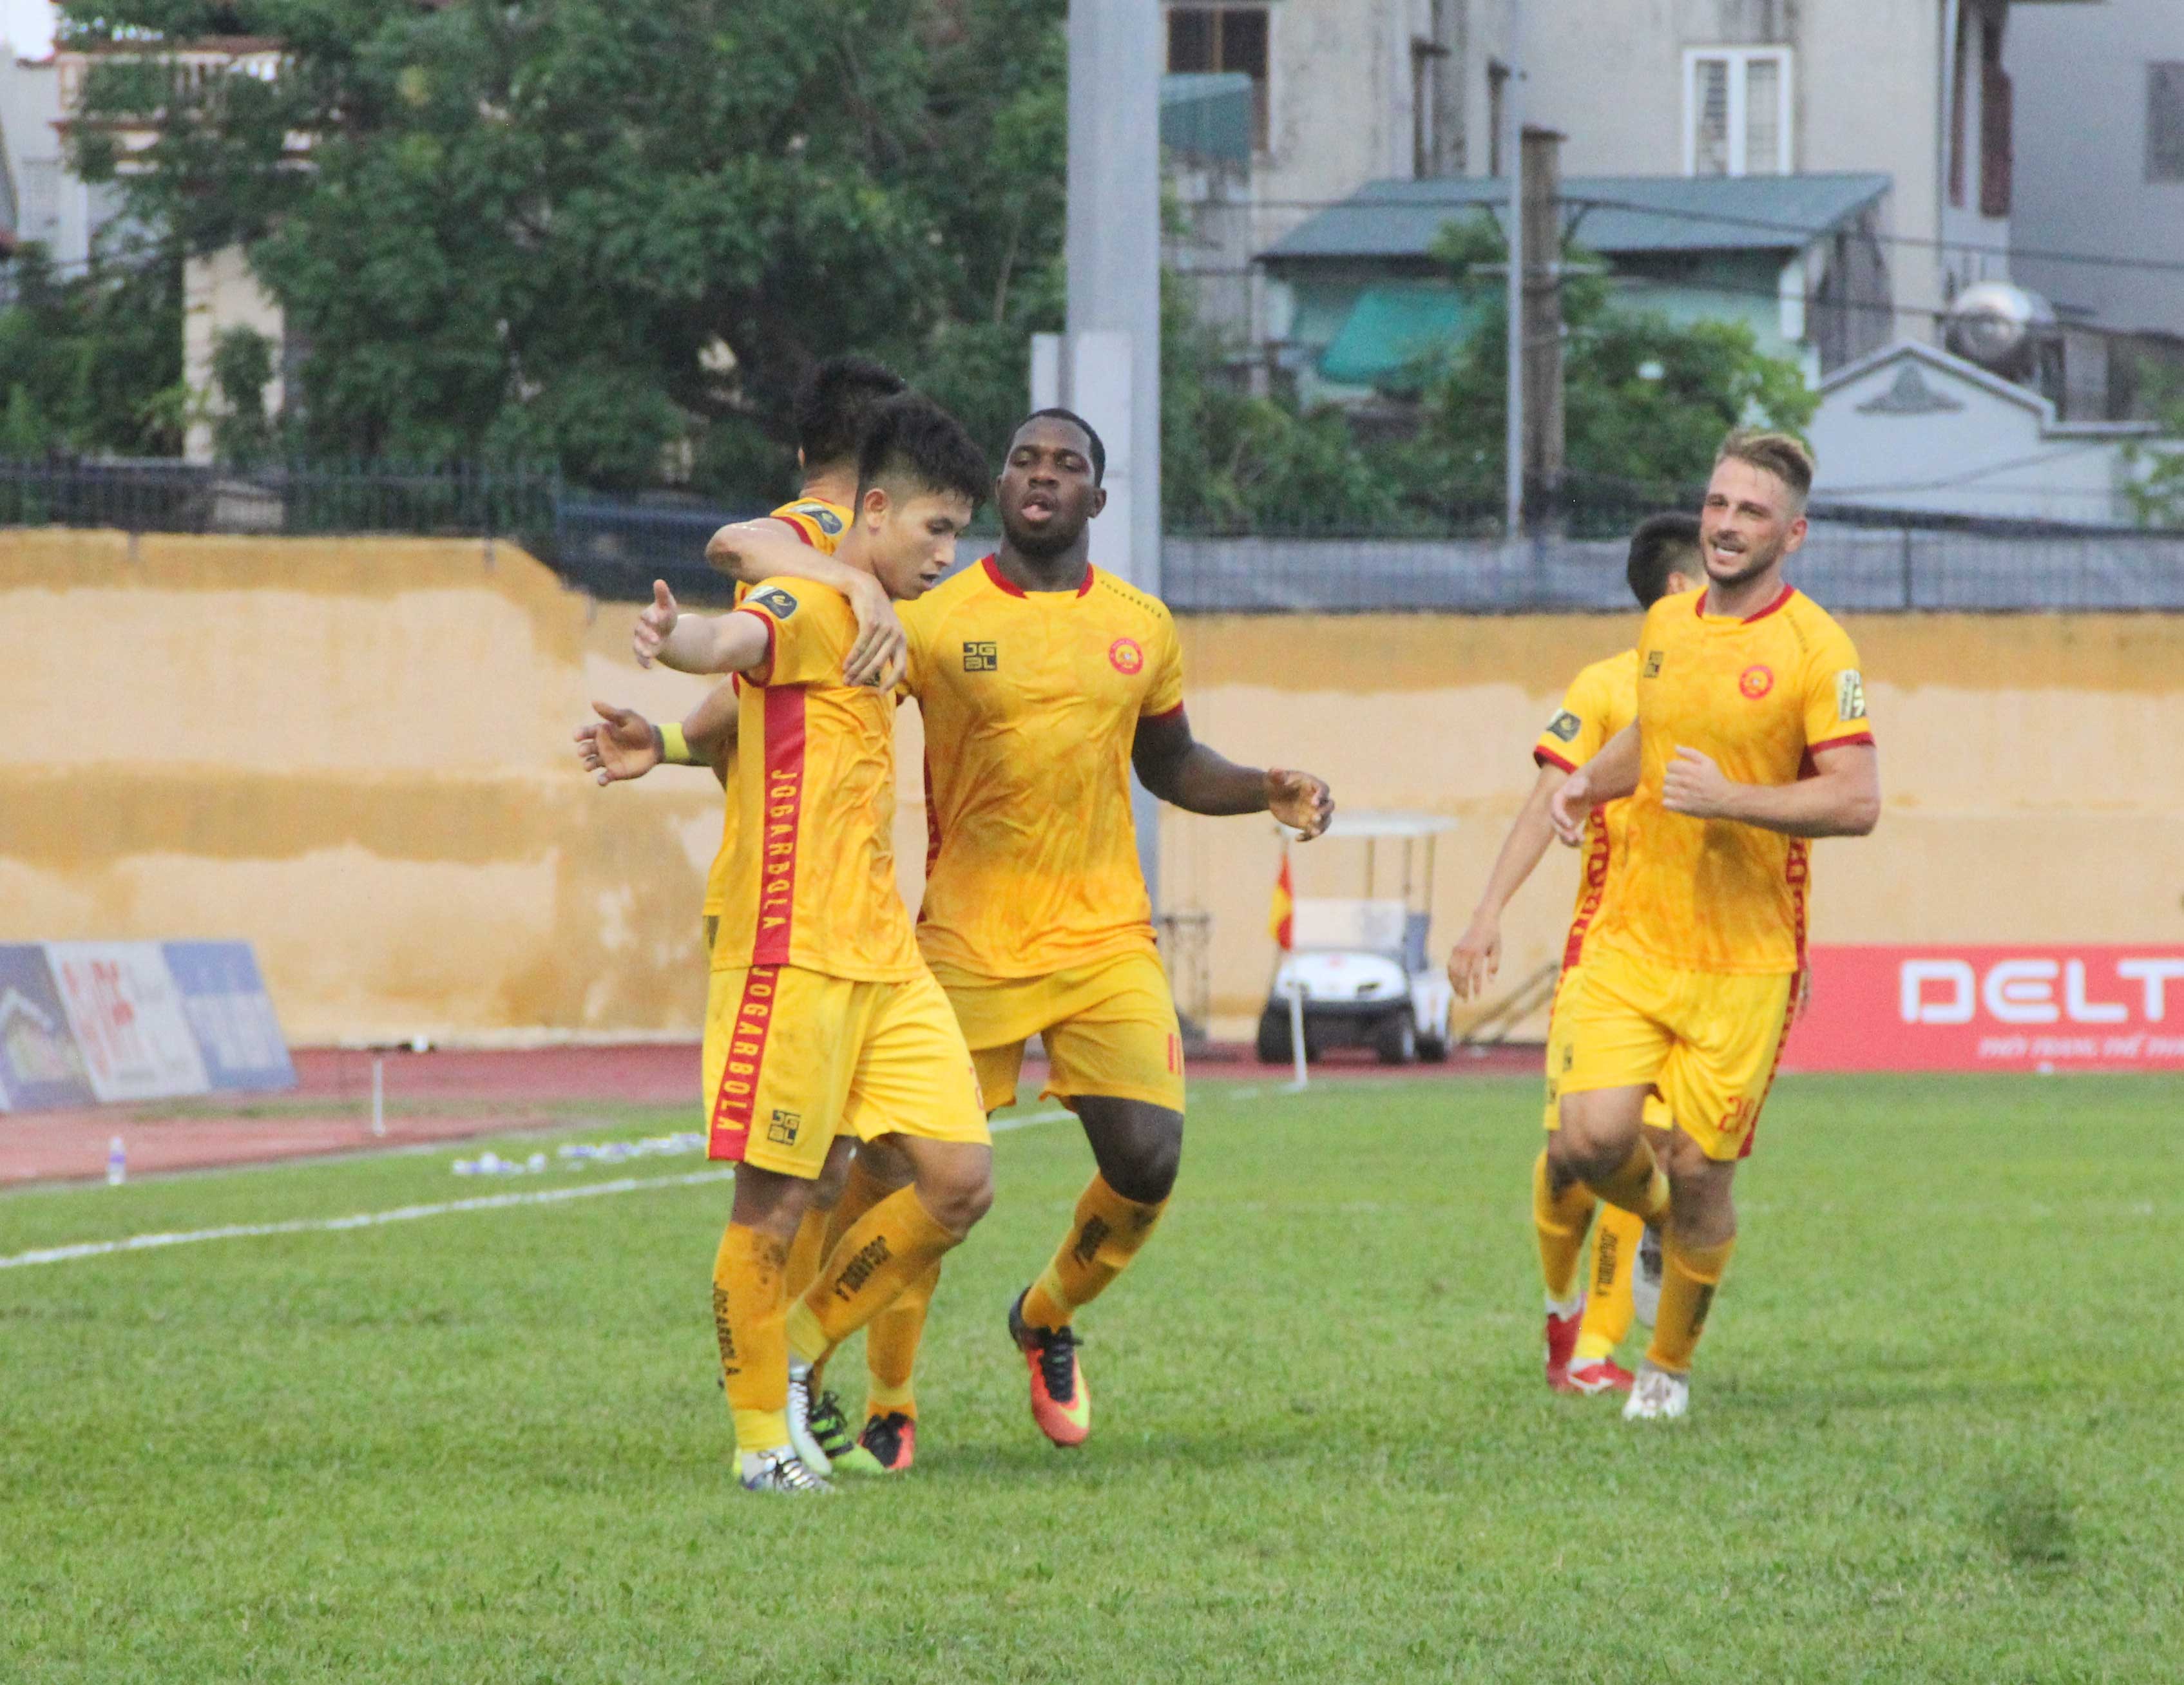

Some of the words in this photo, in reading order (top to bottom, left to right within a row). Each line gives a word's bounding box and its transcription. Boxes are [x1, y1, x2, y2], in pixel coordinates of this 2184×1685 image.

[762, 769, 798, 929] JOGARBOLA
[716, 967, 774, 1130] JOGARBOLA
[1900, 958, 2184, 1023] DELT
